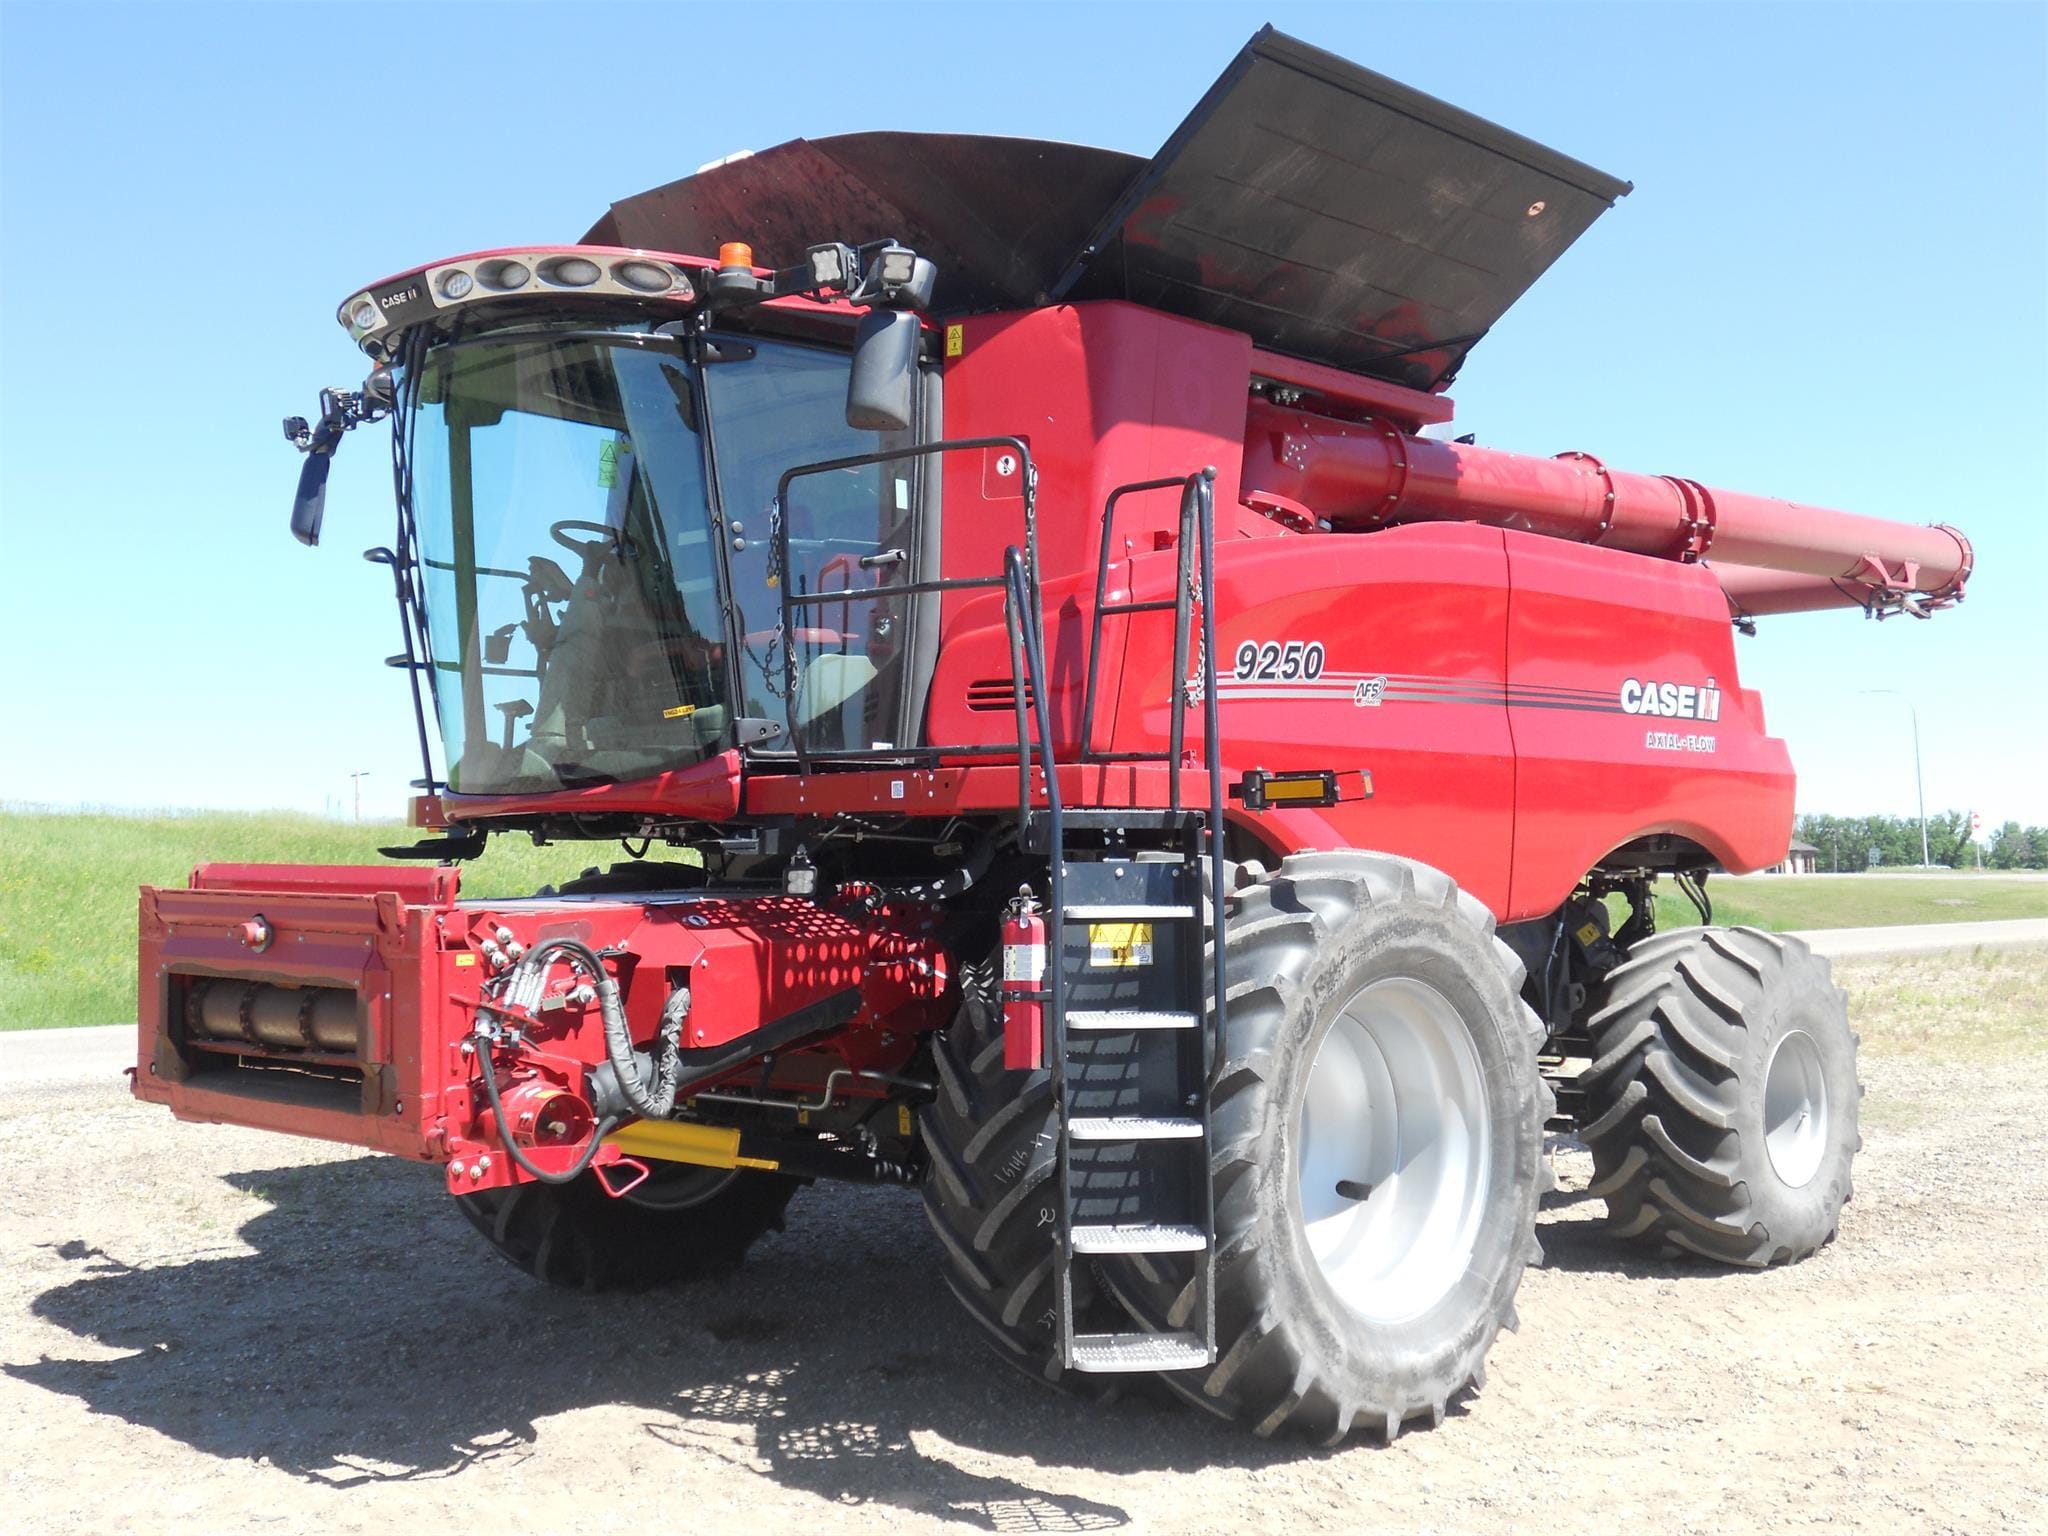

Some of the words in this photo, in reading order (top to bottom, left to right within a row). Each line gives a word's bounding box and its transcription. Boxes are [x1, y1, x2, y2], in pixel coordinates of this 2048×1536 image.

[381, 292, 407, 309] CASE
[1234, 641, 1325, 682] 9250
[1355, 682, 1380, 698] AFS
[1621, 678, 1696, 719] CASE
[1645, 731, 1717, 752] AXIAL-FLOW
